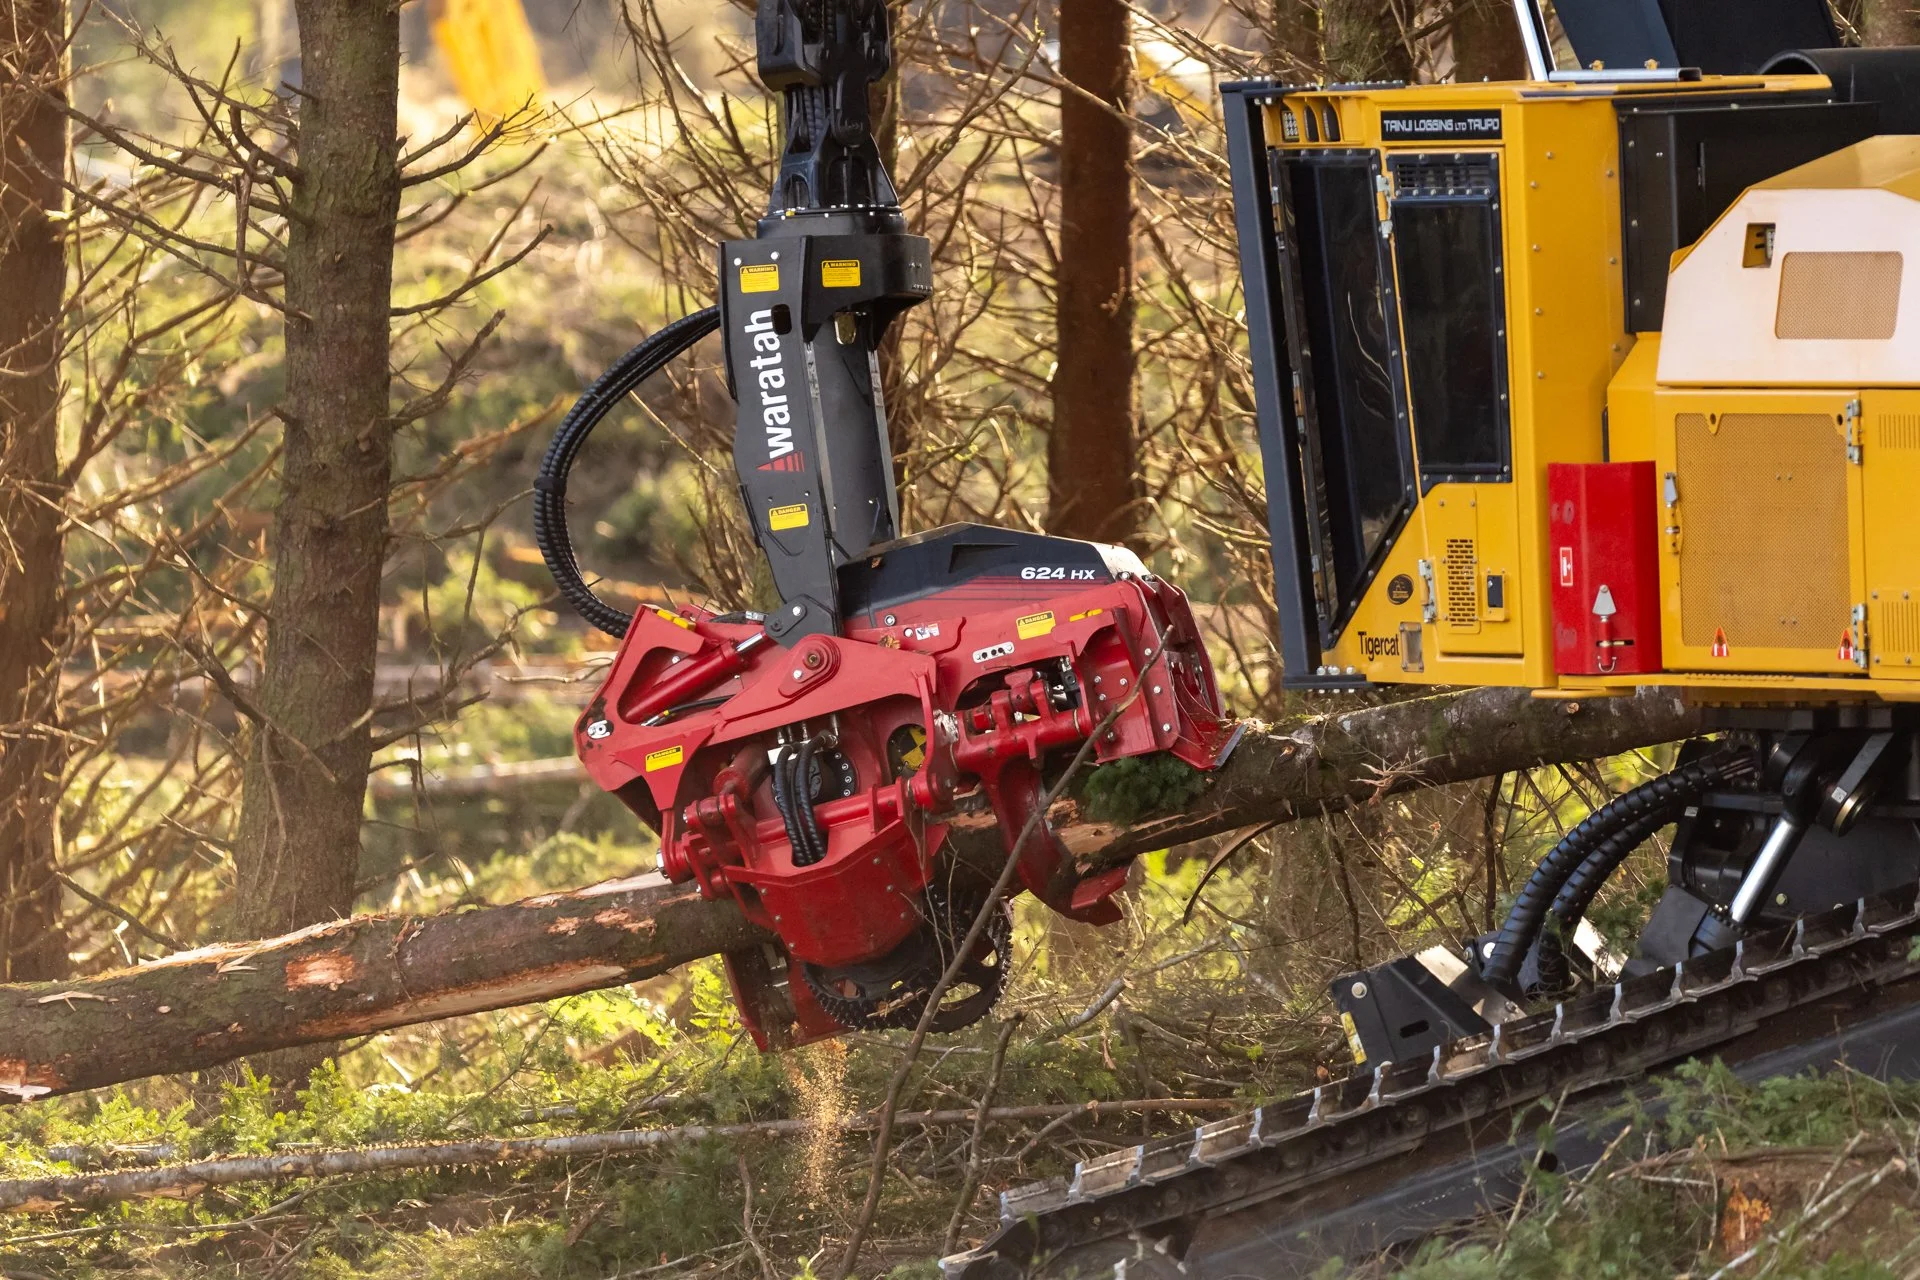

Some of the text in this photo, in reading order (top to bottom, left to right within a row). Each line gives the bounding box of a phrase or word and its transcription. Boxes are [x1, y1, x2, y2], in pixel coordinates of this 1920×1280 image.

[1414, 119, 1453, 131] LOGGING
[1455, 121, 1467, 131] LTD
[1467, 118, 1500, 130] TAUPO
[748, 265, 775, 273] WARNING
[744, 308, 794, 459] waratah
[778, 506, 801, 515] DANGER
[1021, 566, 1095, 580] 624 HX
[1025, 614, 1048, 624] DANGER
[1358, 631, 1400, 661] Tigercat
